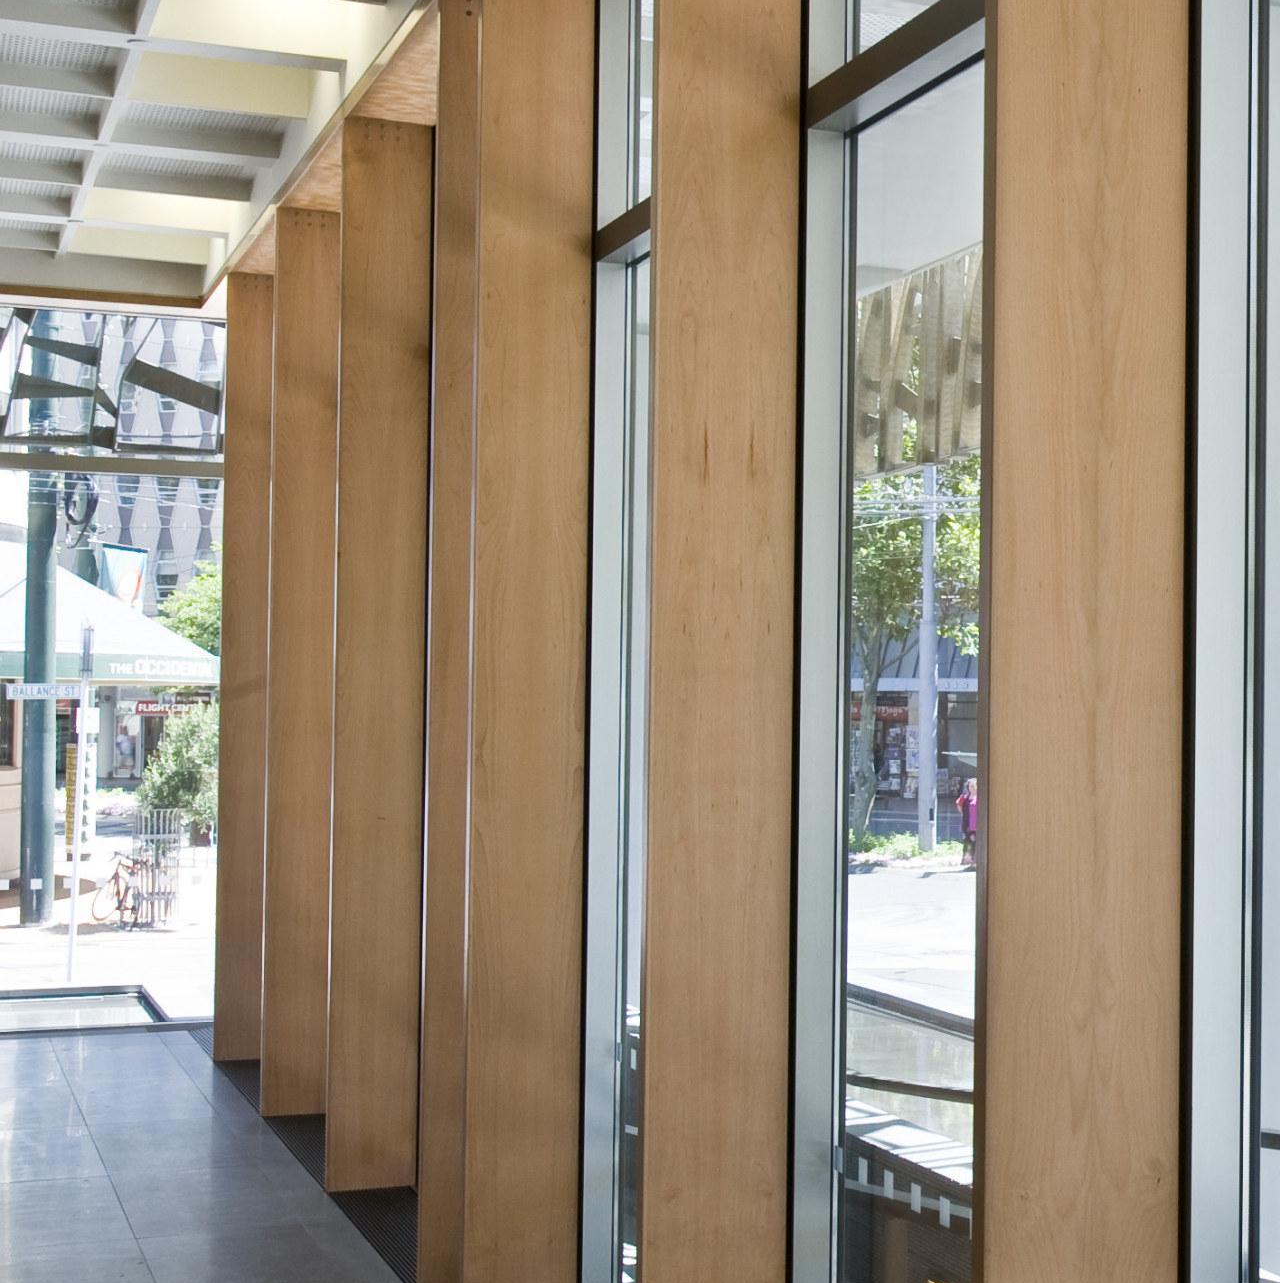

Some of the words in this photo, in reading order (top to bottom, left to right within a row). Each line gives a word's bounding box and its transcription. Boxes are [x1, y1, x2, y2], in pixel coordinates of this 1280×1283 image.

[109, 662, 134, 675] THE
[12, 686, 61, 697] BALLANCE
[64, 686, 76, 697] ST
[138, 702, 169, 713] FLIGHT
